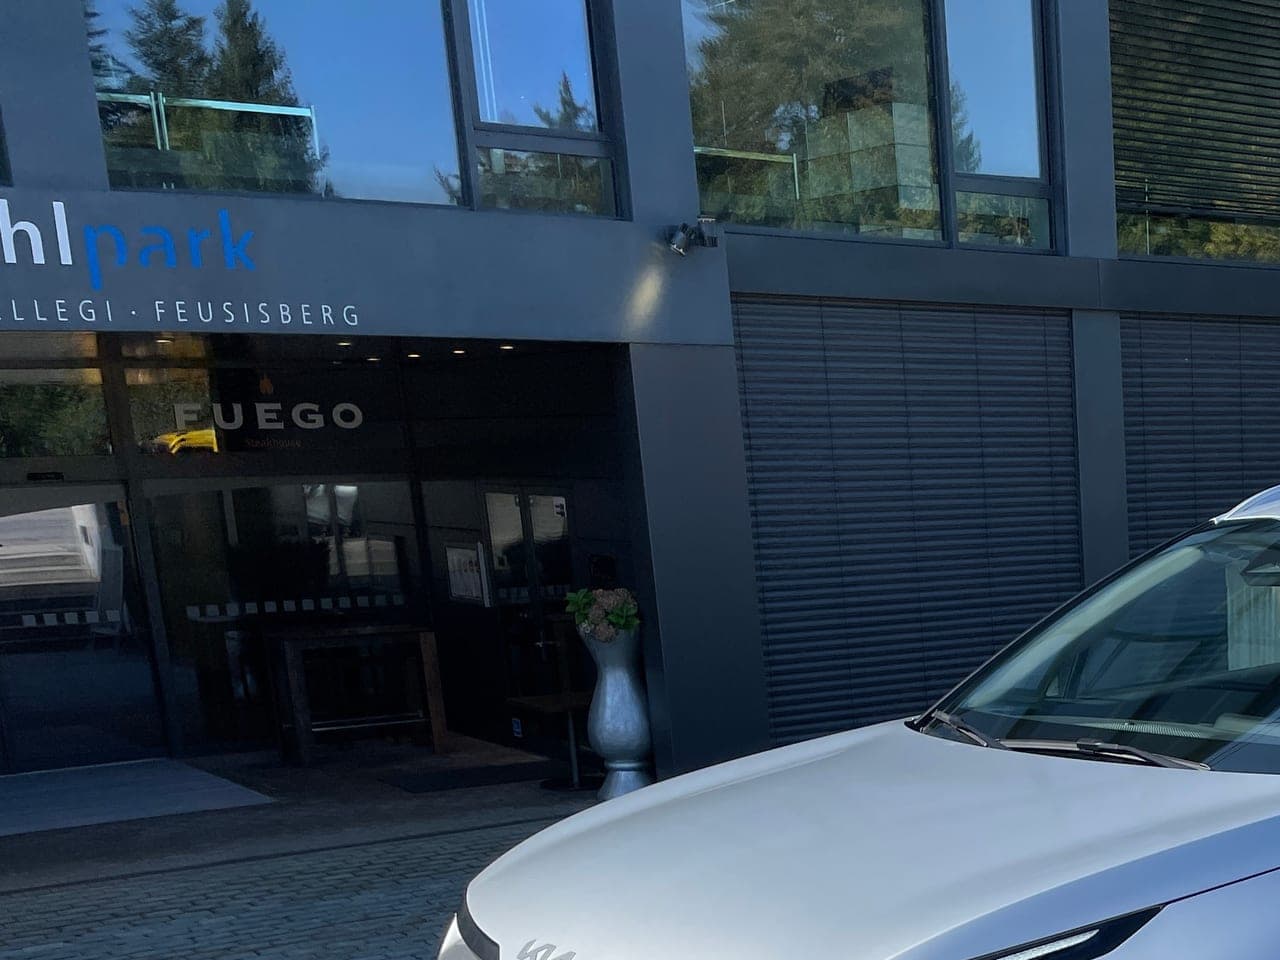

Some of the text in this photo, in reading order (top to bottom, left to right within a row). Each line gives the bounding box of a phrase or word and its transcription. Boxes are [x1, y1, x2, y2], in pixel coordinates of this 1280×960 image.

[0, 299, 358, 326] LLEGI FEUSISBERG
[174, 402, 363, 430] FUEGO
